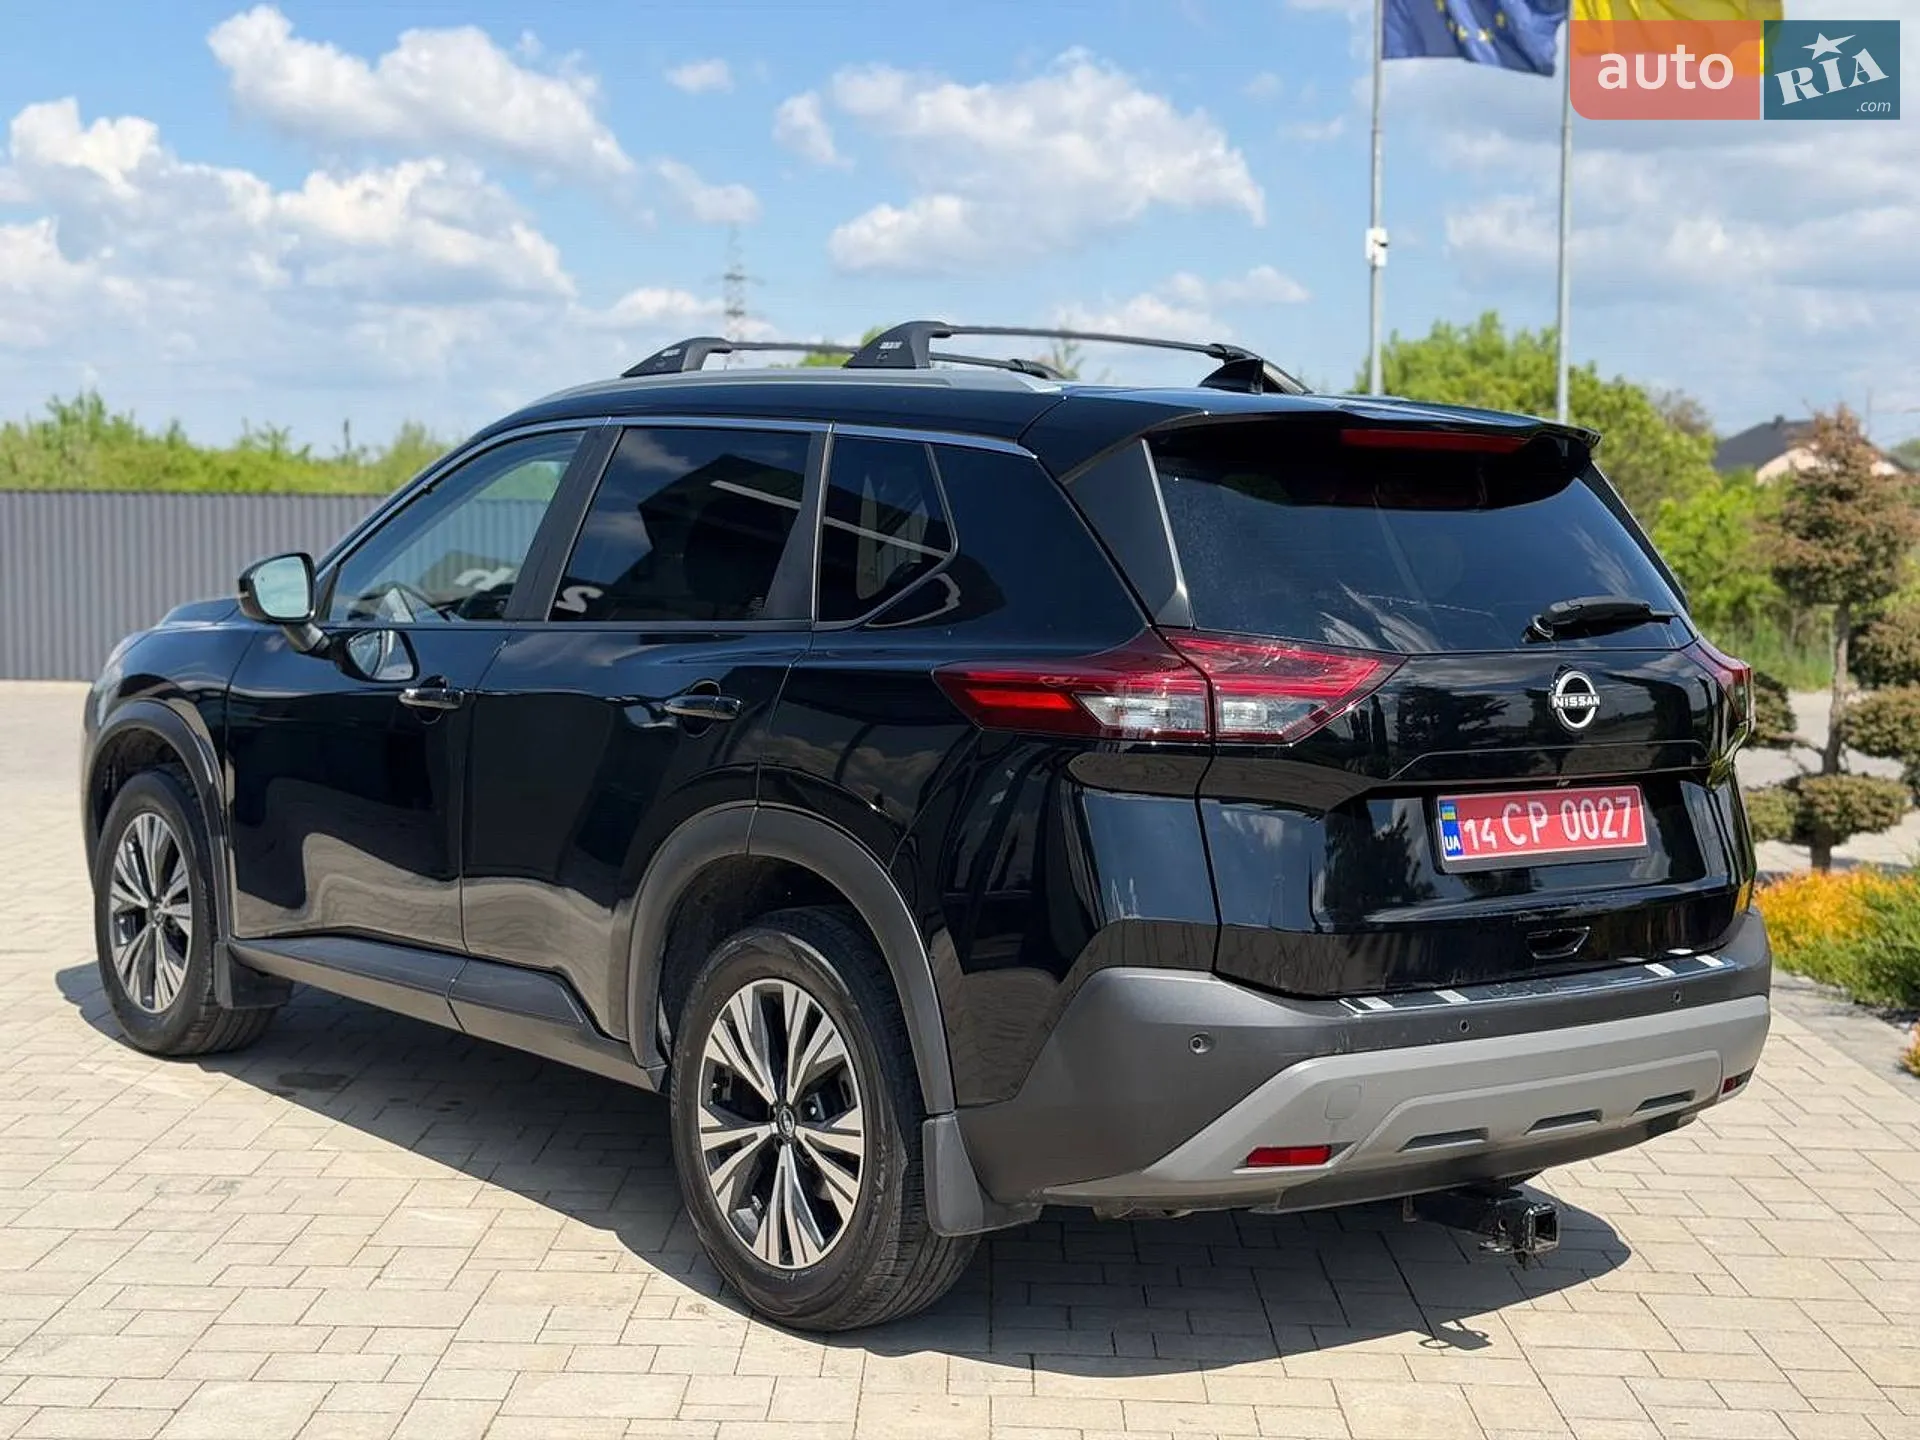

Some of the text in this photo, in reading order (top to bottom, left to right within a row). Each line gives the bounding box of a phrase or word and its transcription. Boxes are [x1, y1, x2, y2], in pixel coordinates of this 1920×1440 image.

[1553, 696, 1600, 708] NISSAN
[1463, 796, 1632, 850] 14 CP 0027
[1444, 835, 1461, 851] UA
